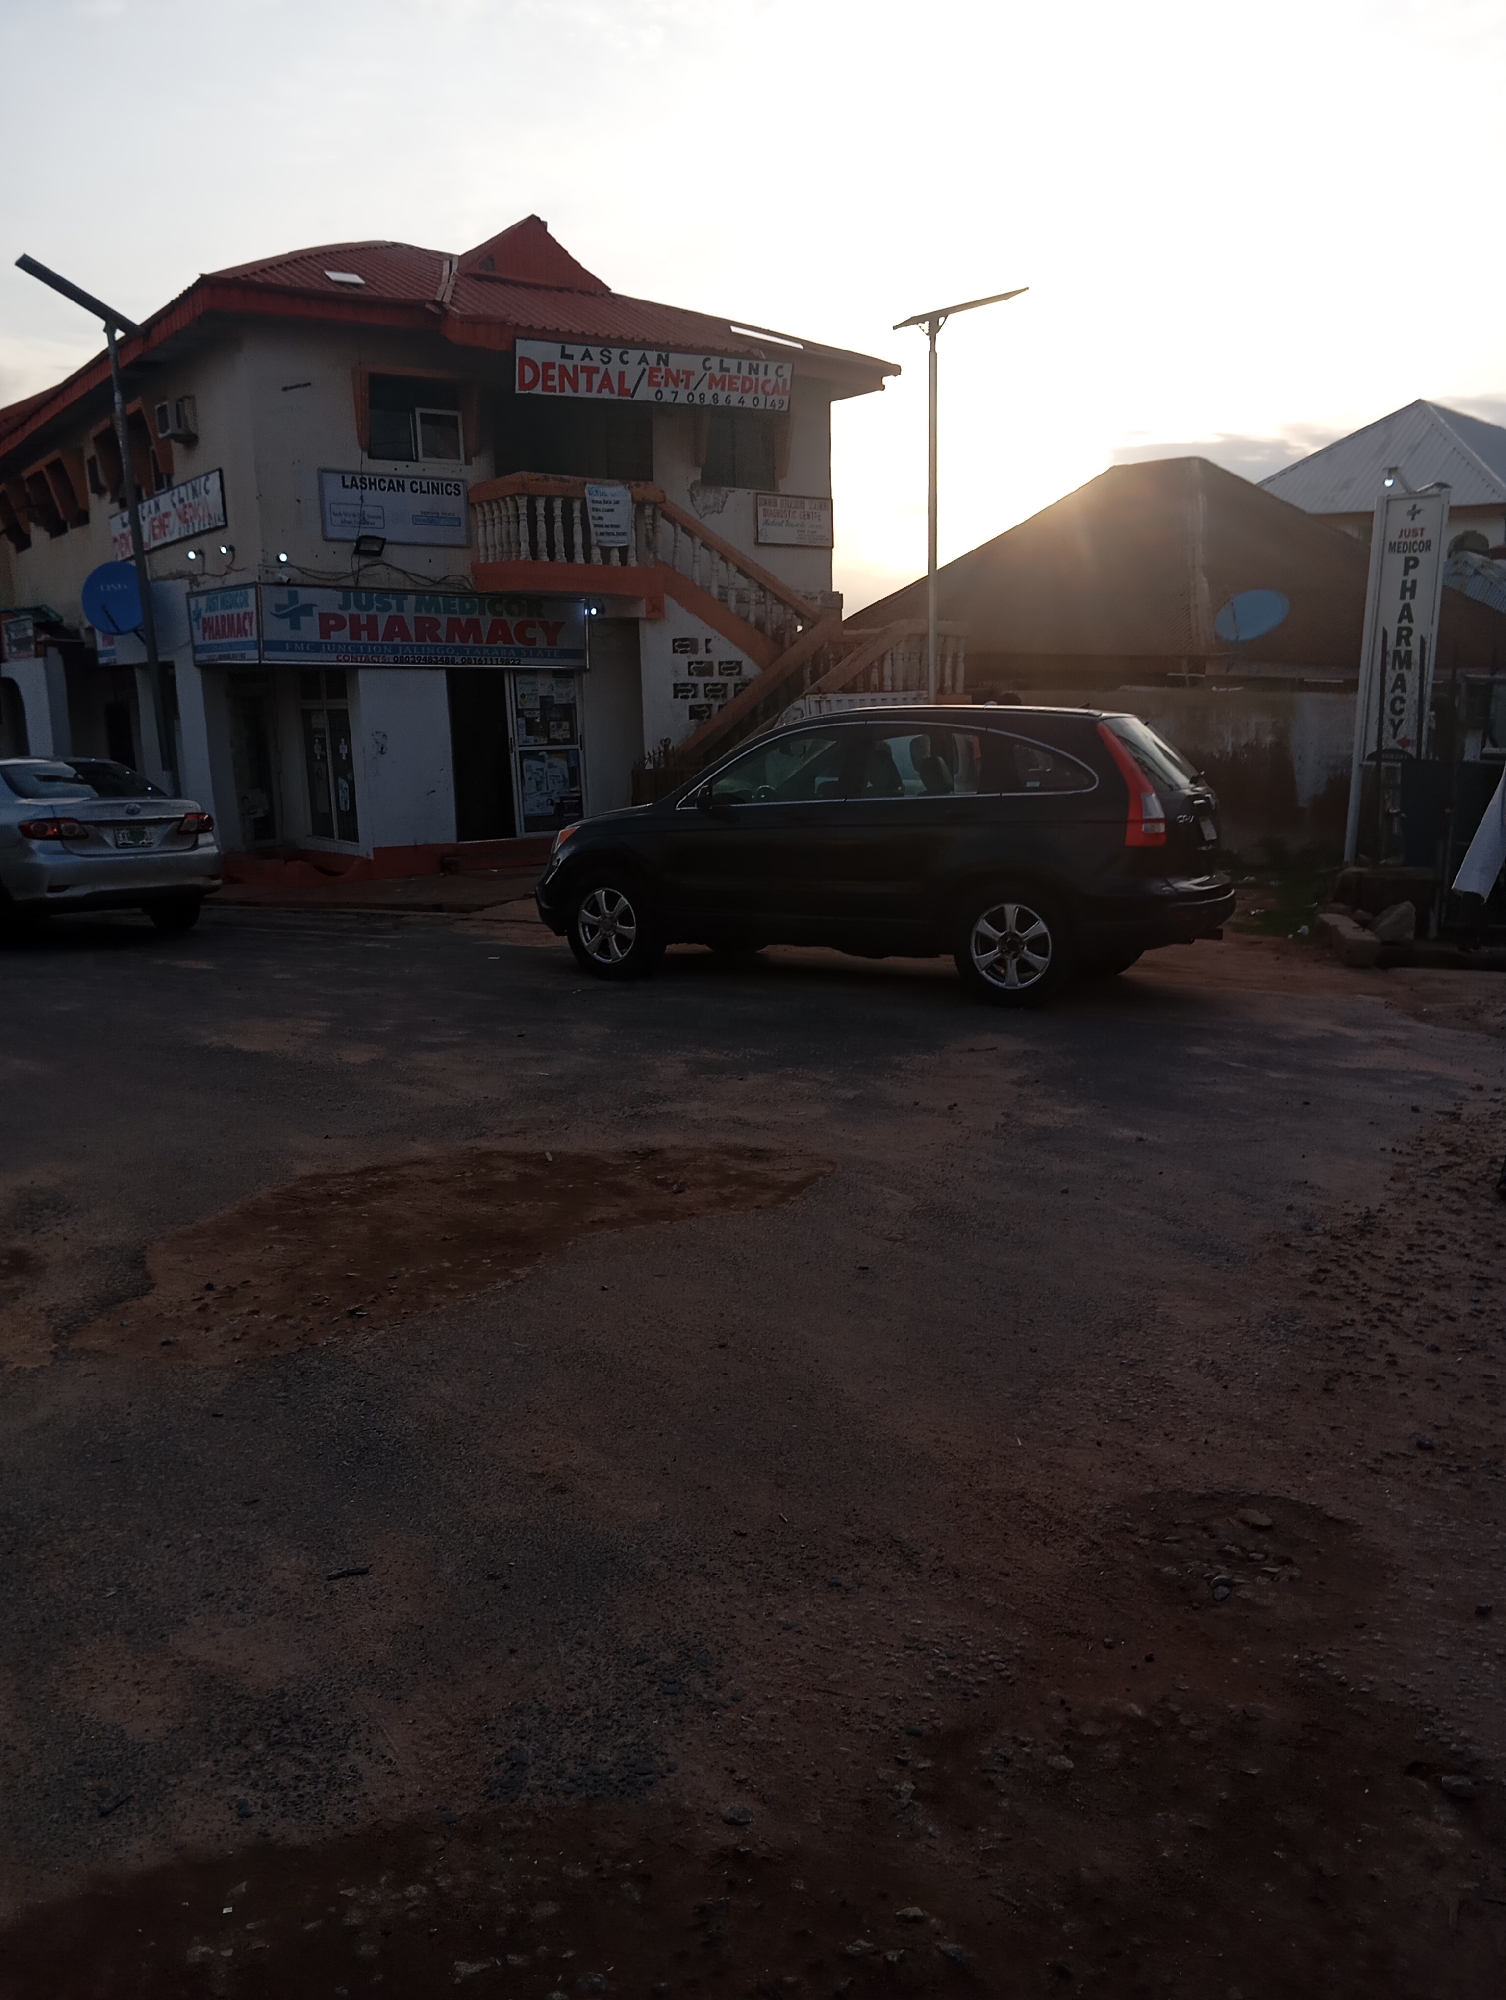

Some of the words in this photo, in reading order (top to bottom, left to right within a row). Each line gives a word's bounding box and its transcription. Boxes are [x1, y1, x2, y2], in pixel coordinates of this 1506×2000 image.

[560, 345, 670, 367] LASCAN
[702, 357, 785, 378] CLINIC
[341, 475, 405, 493] LASHCAN
[410, 480, 461, 496] CLINICS
[1388, 539, 1432, 554] MEDICOR
[1398, 527, 1425, 539] JUST
[338, 591, 408, 613] JUST
[414, 594, 546, 618] MEDICOR
[202, 611, 254, 641] PHARMACY
[318, 612, 565, 647] PHARMACY
[285, 642, 315, 652] FMC
[321, 643, 392, 653] JUNCTION
[464, 647, 516, 657] TARABA
[1389, 556, 1420, 740] PHARMACY
